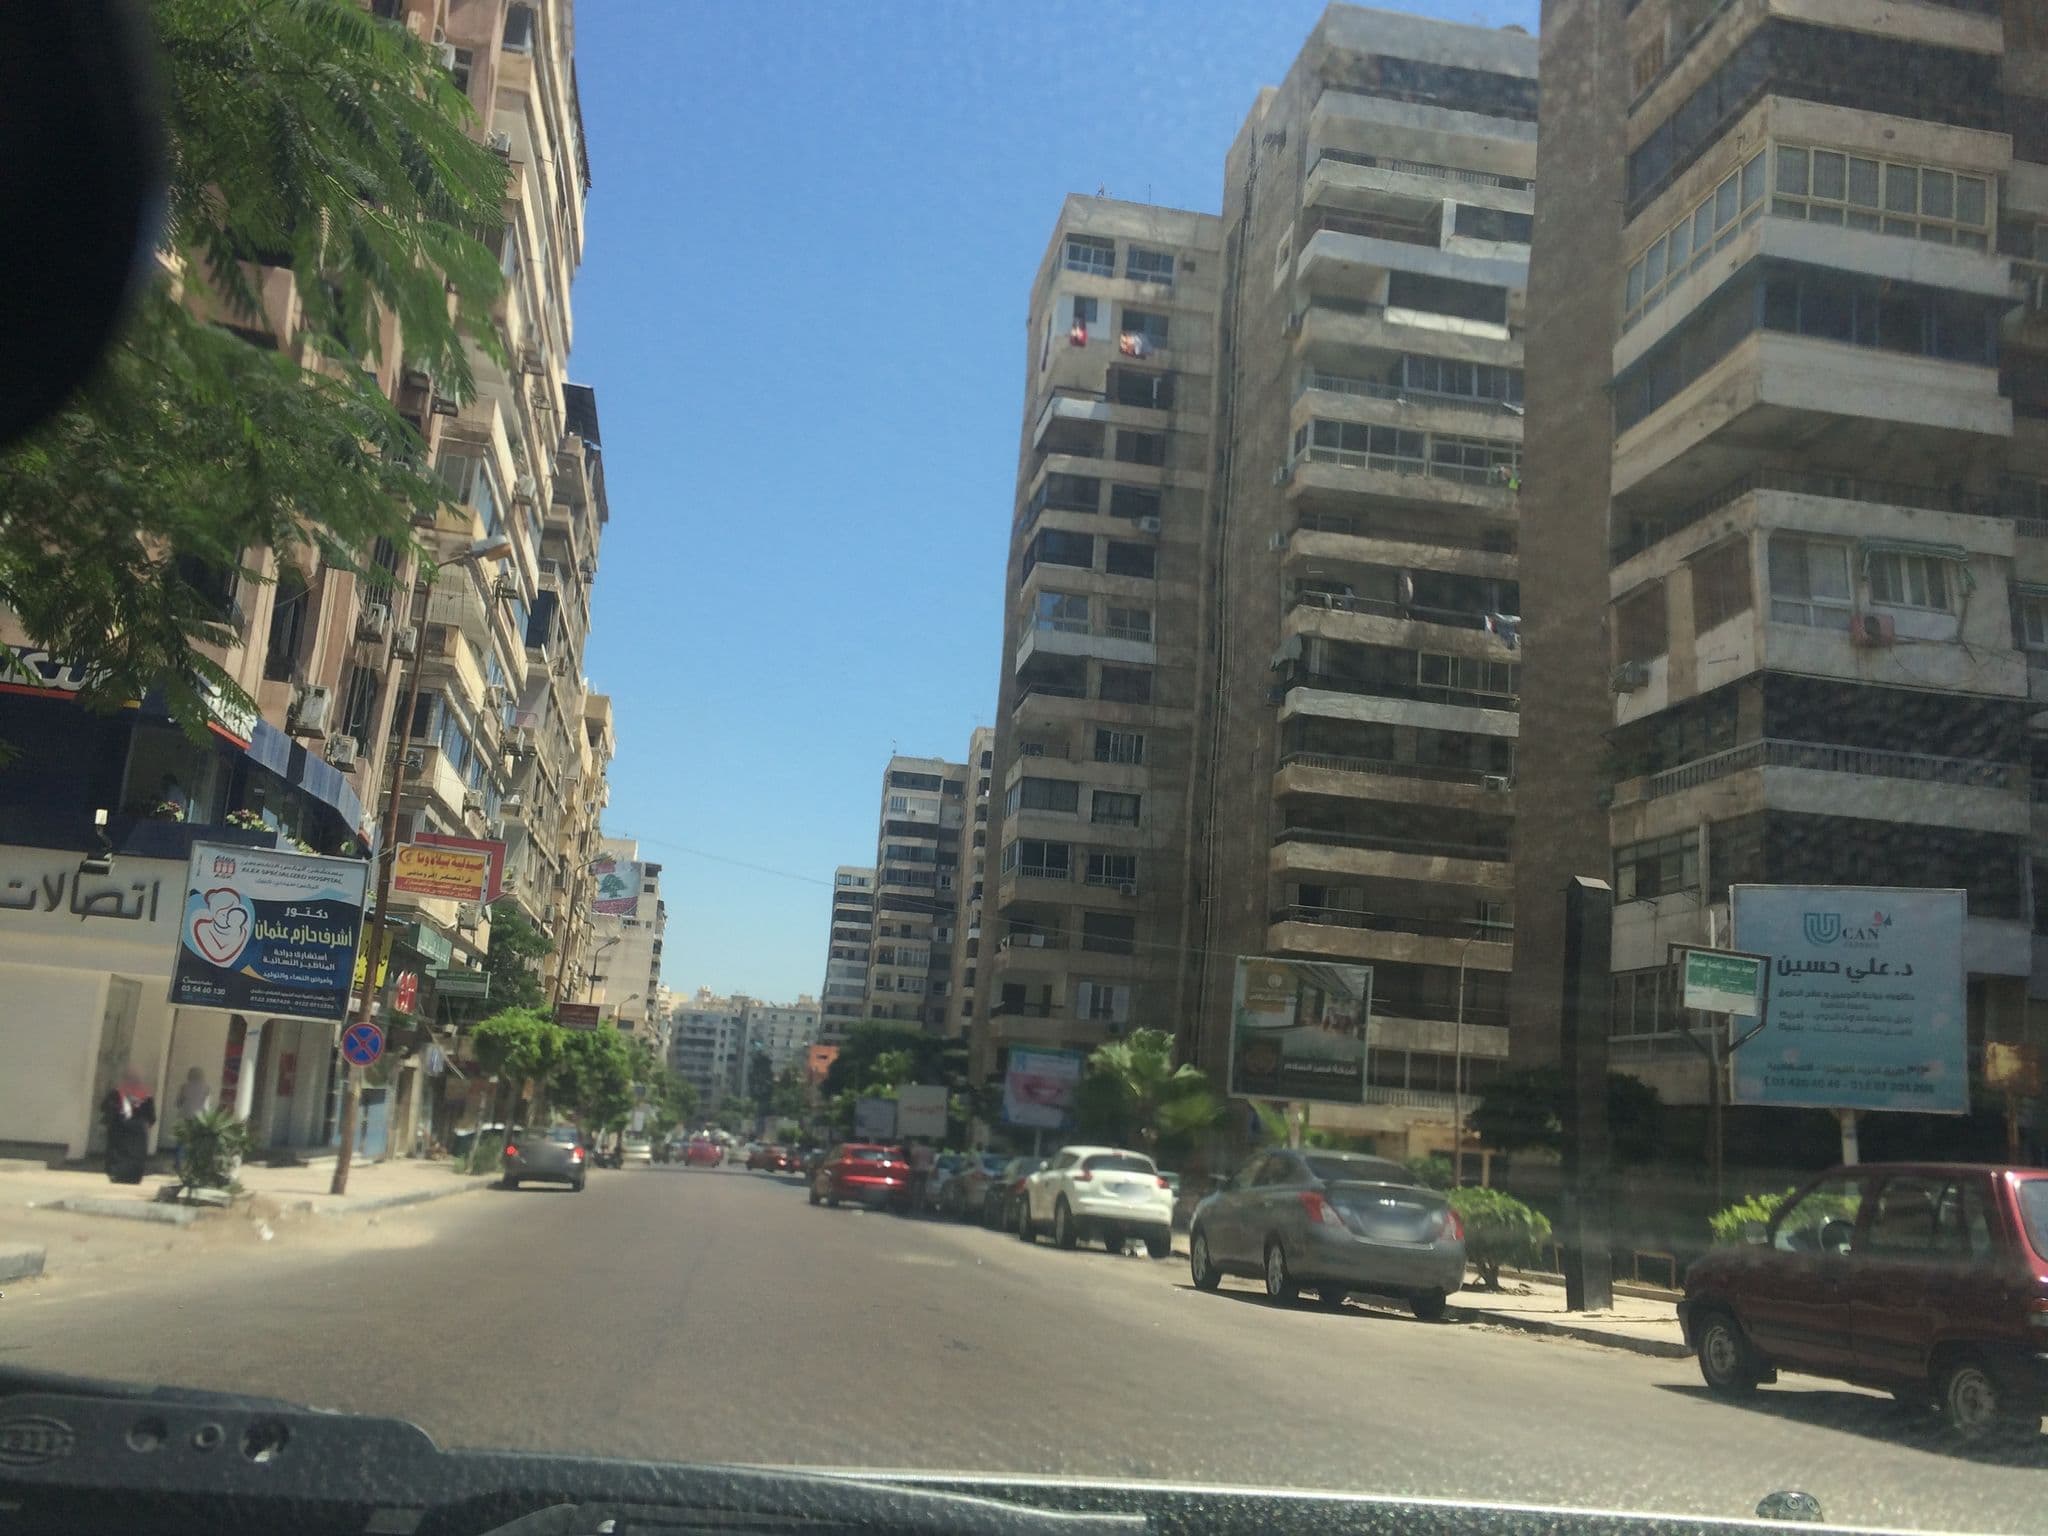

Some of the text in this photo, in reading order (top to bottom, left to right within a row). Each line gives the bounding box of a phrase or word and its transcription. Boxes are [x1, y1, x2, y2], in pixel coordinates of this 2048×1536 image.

[284, 907, 329, 919] دكتور
[254, 919, 352, 948] أشرف حازم عثمان
[1777, 955, 1840, 977] حسين
[1845, 957, 1889, 984] علي
